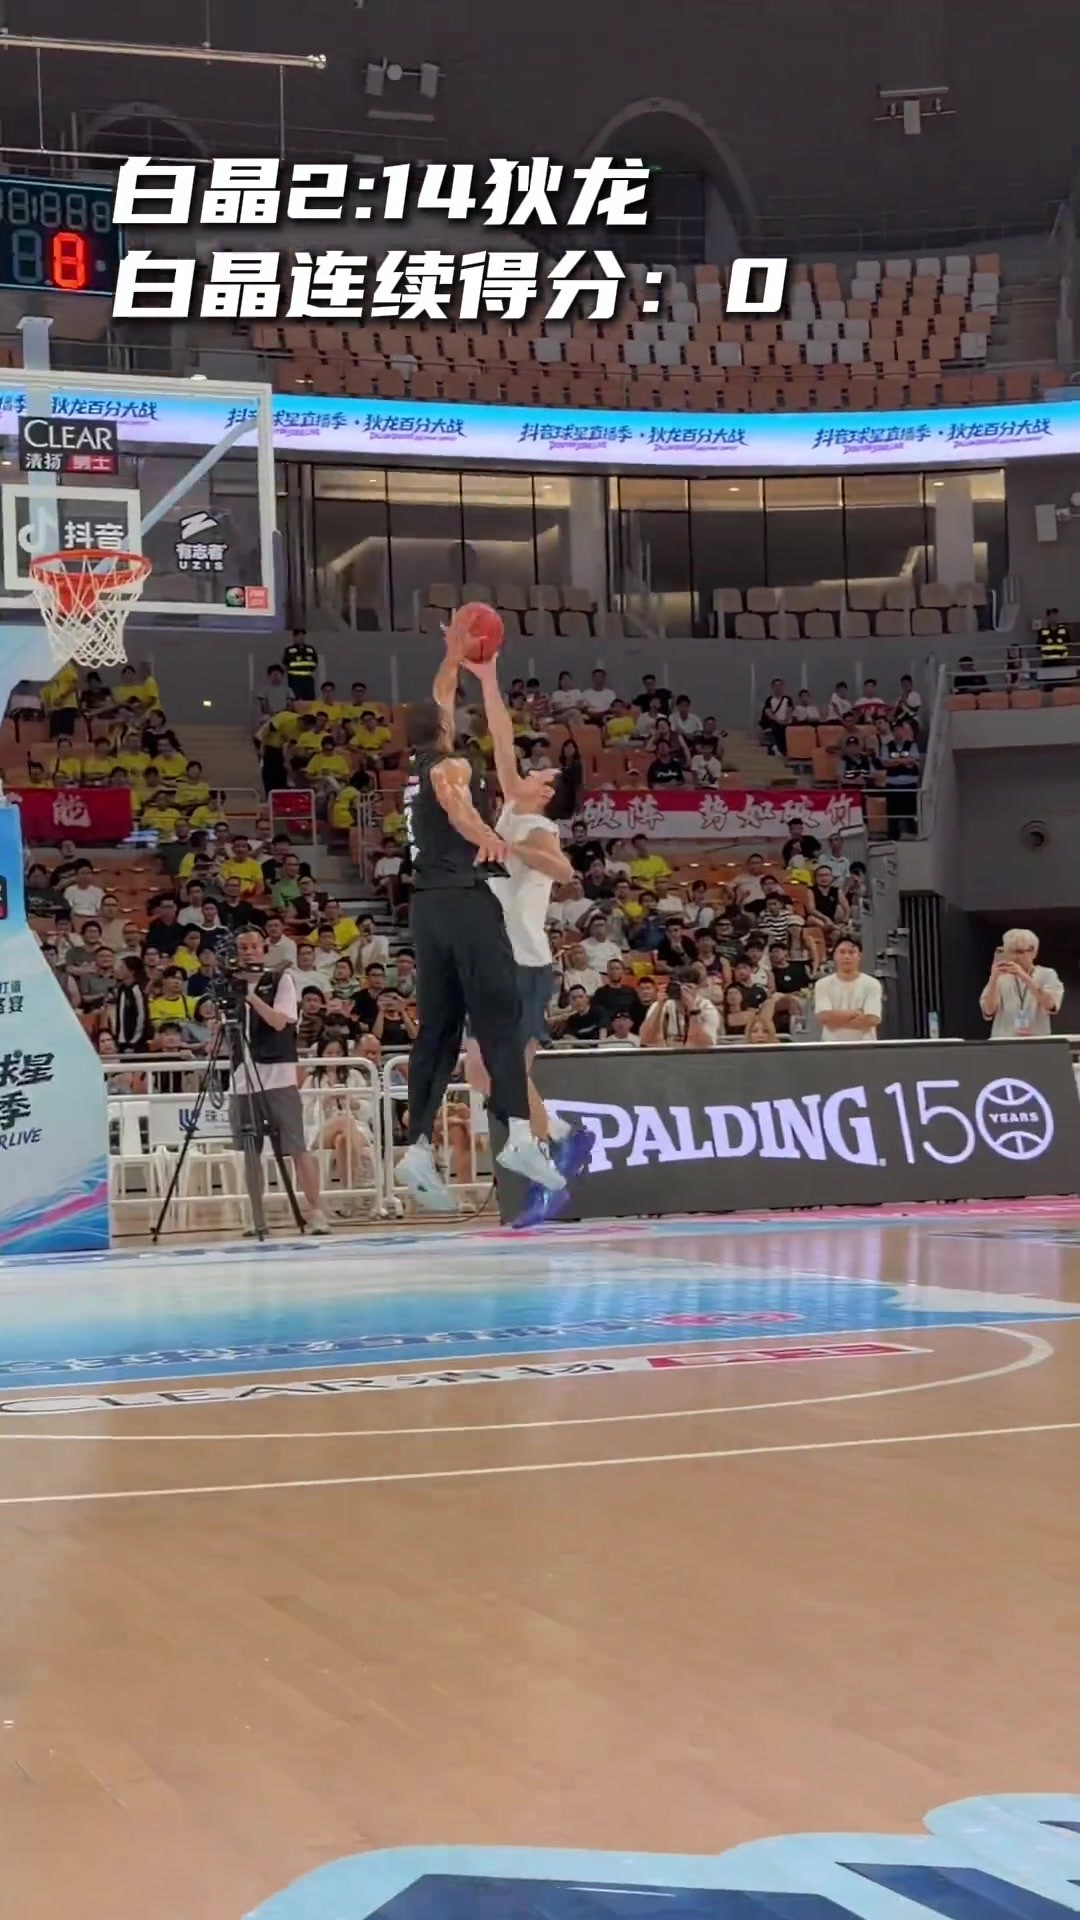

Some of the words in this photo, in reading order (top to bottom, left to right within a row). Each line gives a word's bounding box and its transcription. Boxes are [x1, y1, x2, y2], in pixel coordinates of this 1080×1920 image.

[23, 419, 113, 451] CLEAR
[25, 452, 63, 471] 清扬
[64, 521, 125, 550] 抖音
[176, 543, 226, 561] 有志者
[179, 561, 224, 571] UZIS
[989, 1112, 1039, 1124] YEARS
